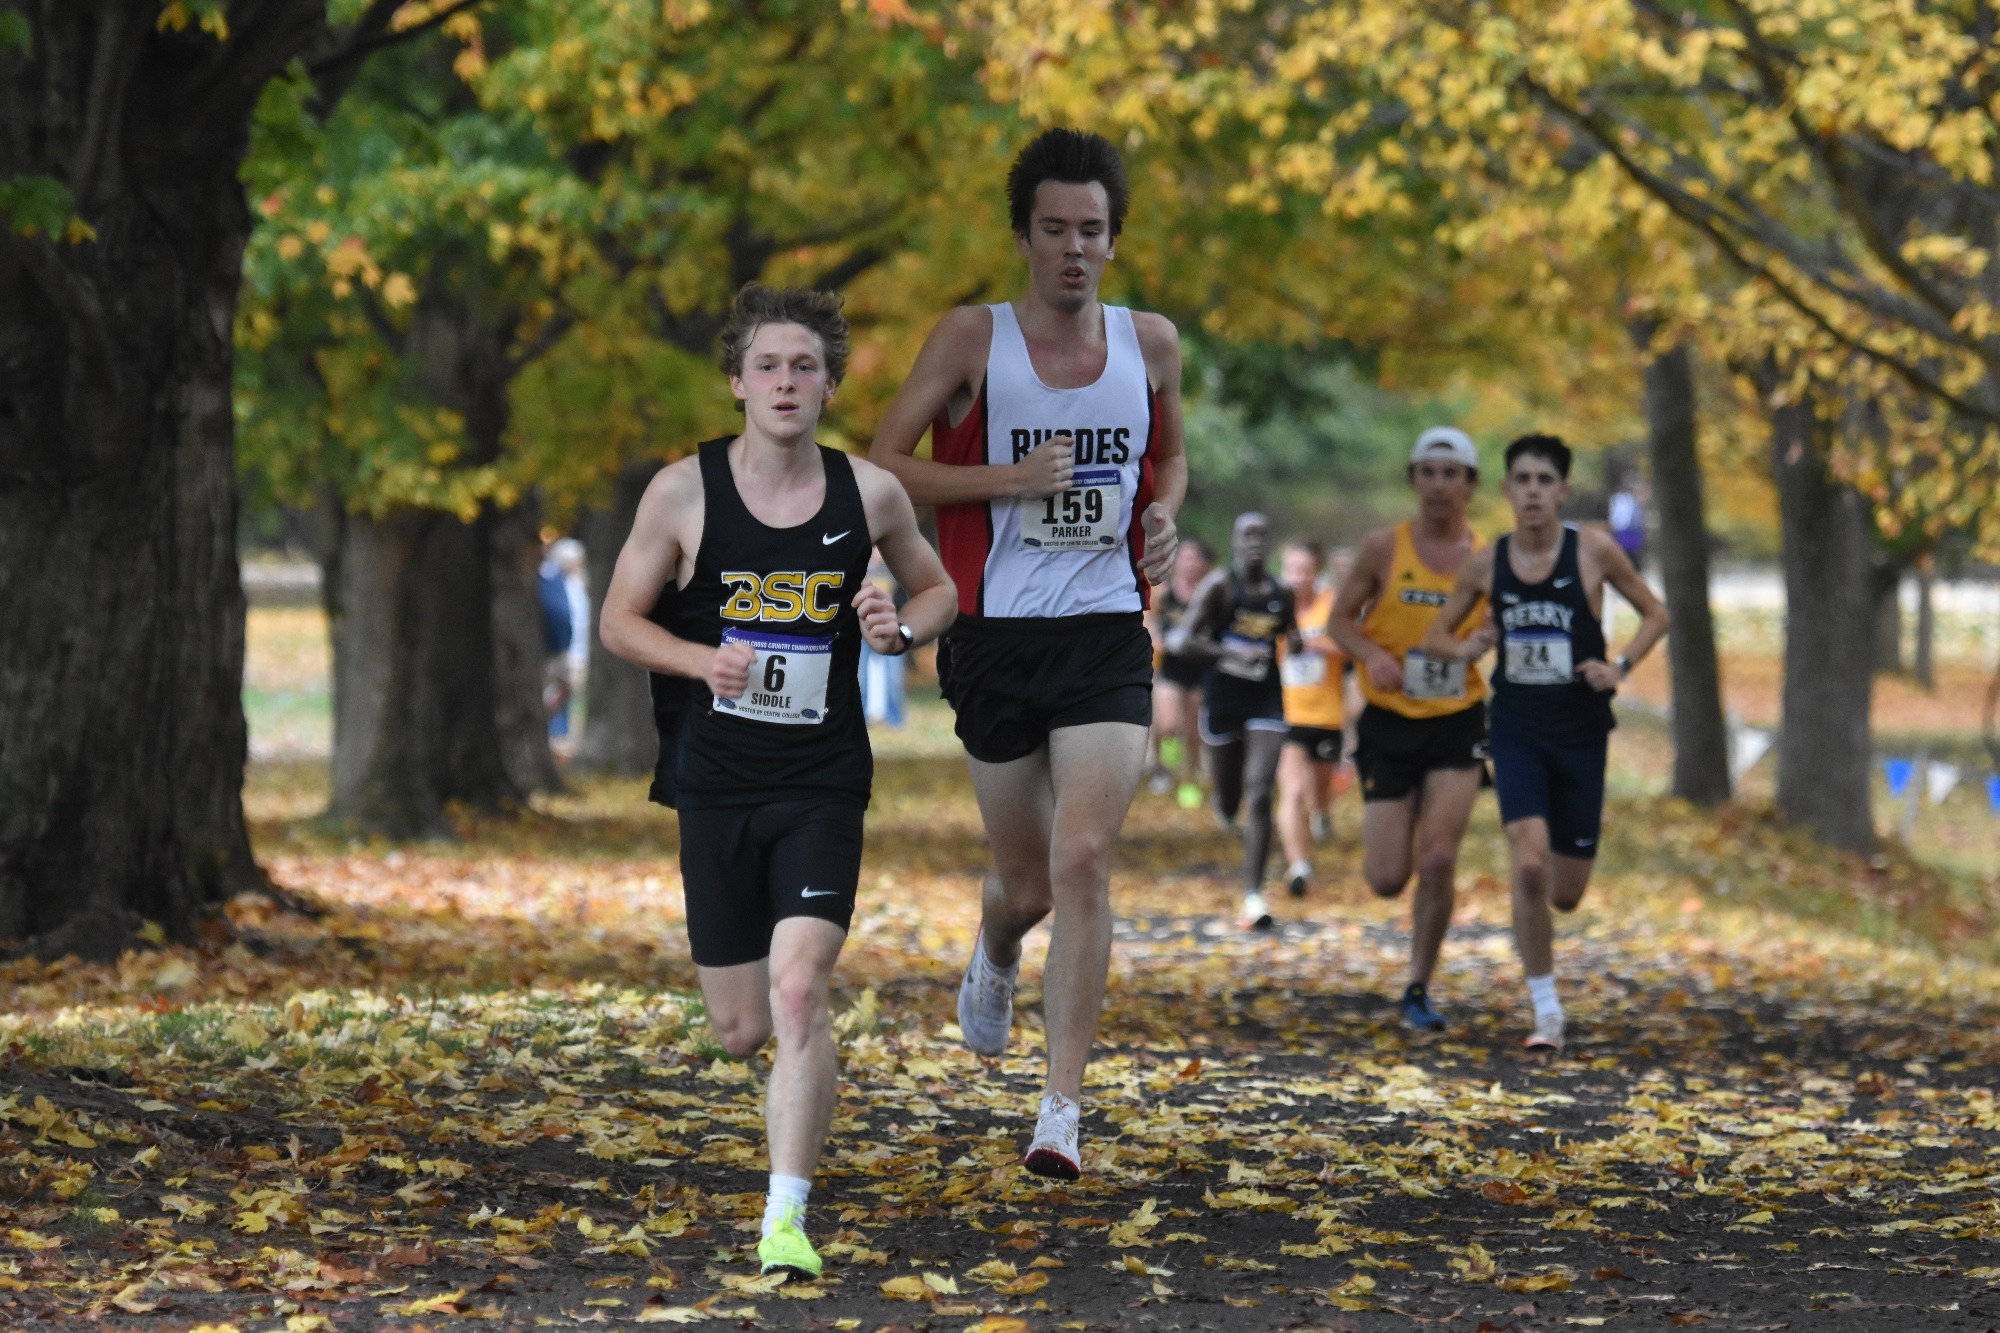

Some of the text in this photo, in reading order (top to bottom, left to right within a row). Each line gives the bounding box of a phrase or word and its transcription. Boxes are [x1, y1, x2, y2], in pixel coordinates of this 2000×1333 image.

[1010, 428, 1130, 465] RDES
[1042, 489, 1102, 524] 159
[1052, 526, 1092, 538] PARKER
[720, 571, 844, 622] BSC
[1502, 600, 1575, 633] BERRY
[1522, 644, 1551, 668] 24
[764, 654, 787, 693] 6
[751, 692, 792, 709] SIDDLE
